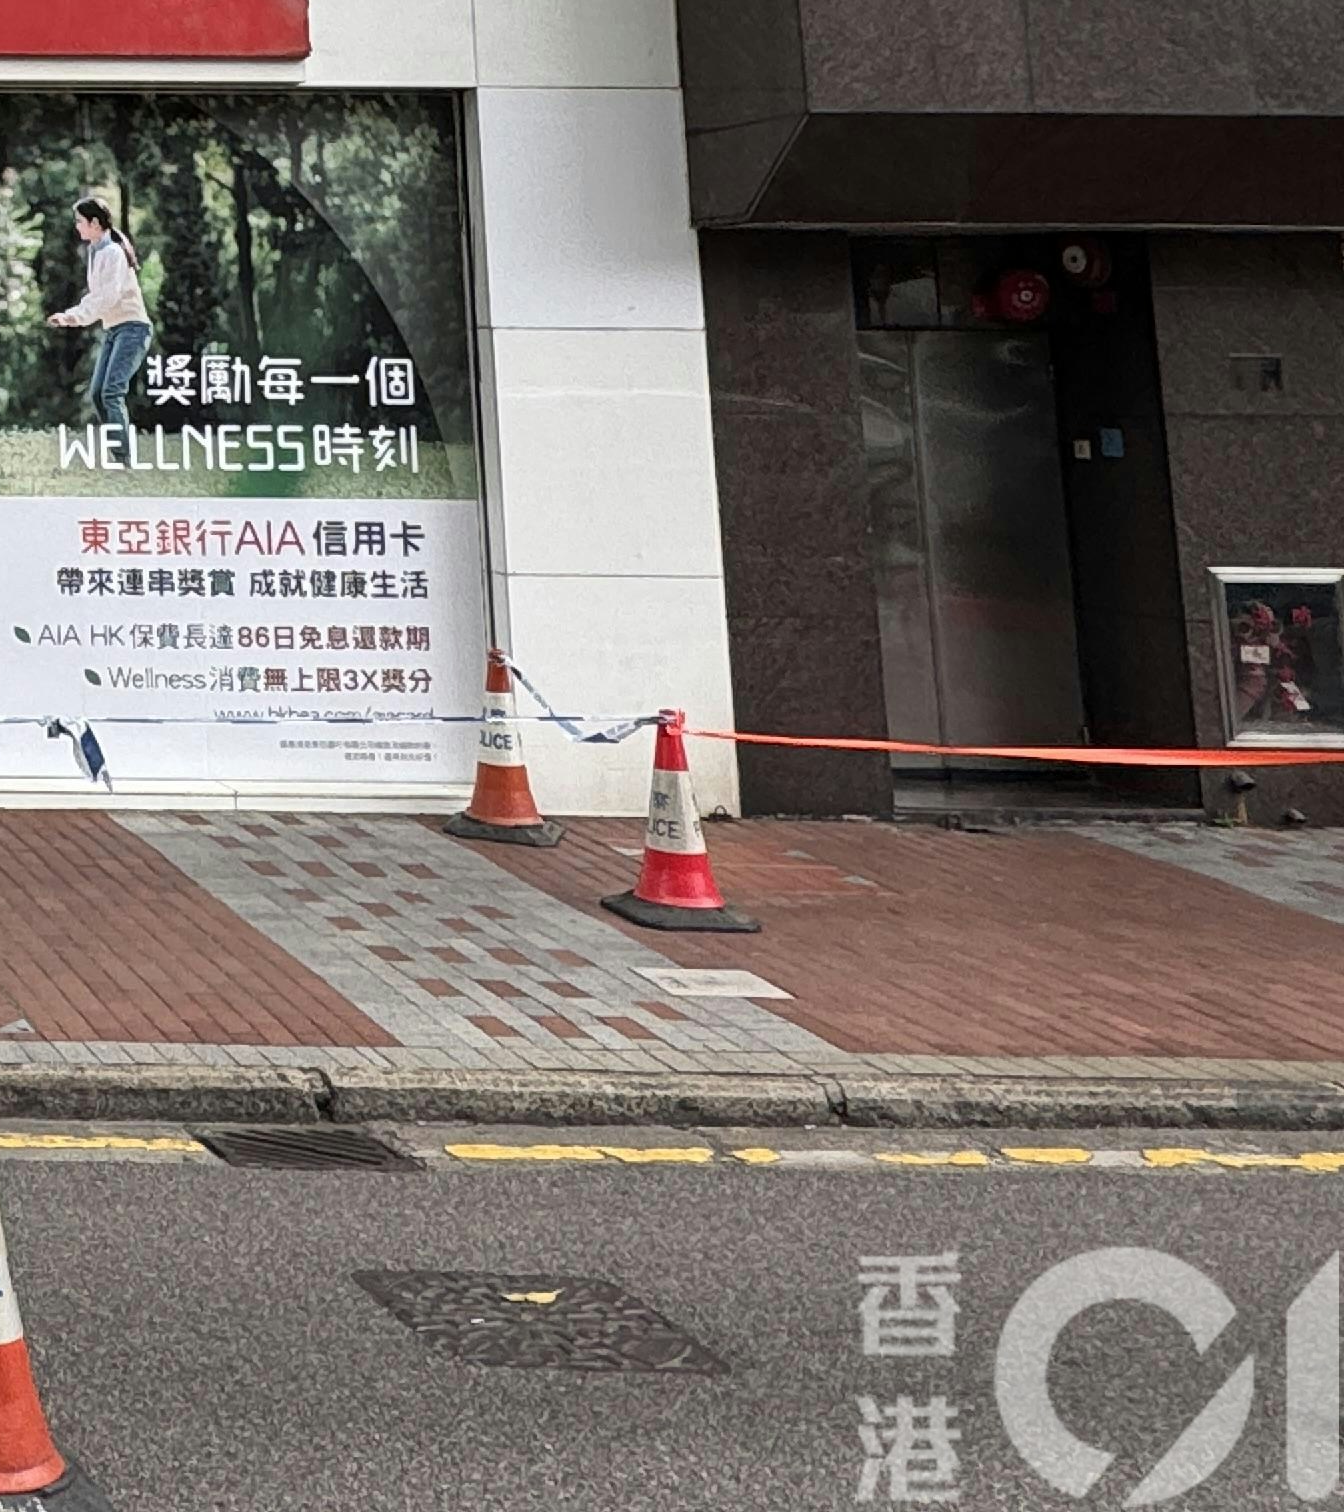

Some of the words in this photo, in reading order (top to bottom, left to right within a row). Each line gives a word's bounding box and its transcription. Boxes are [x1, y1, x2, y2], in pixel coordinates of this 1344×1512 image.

[145, 353, 416, 407] 獎勵每一個
[312, 519, 426, 557] 信用卡
[56, 567, 236, 598] 帶來連串獎賞
[249, 568, 430, 599] 成就健康生活
[37, 624, 82, 647] AIA
